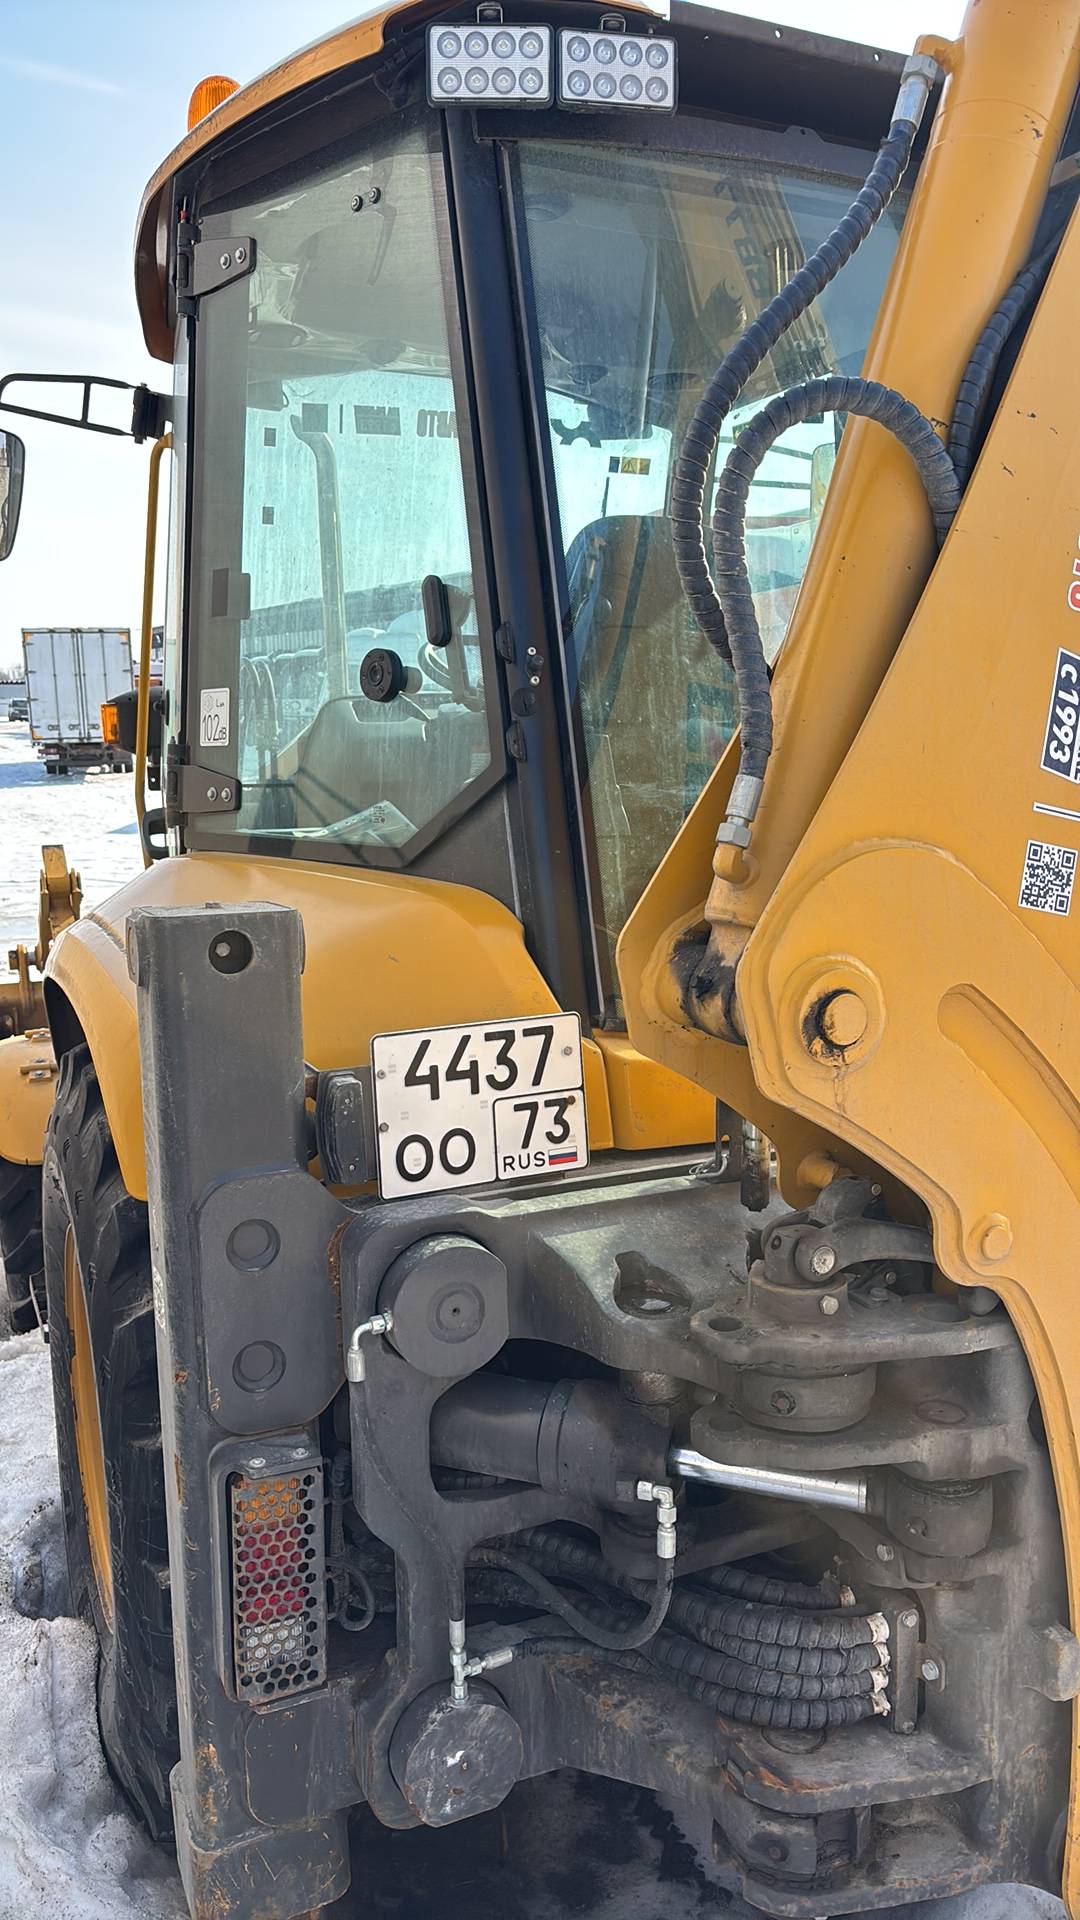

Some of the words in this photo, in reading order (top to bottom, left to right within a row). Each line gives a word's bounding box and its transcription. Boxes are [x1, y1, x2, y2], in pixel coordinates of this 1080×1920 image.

[1049, 689, 1080, 764] 1993
[404, 1025, 554, 1101] 4437
[513, 1097, 571, 1150] 73
[502, 1151, 546, 1173] RUS
